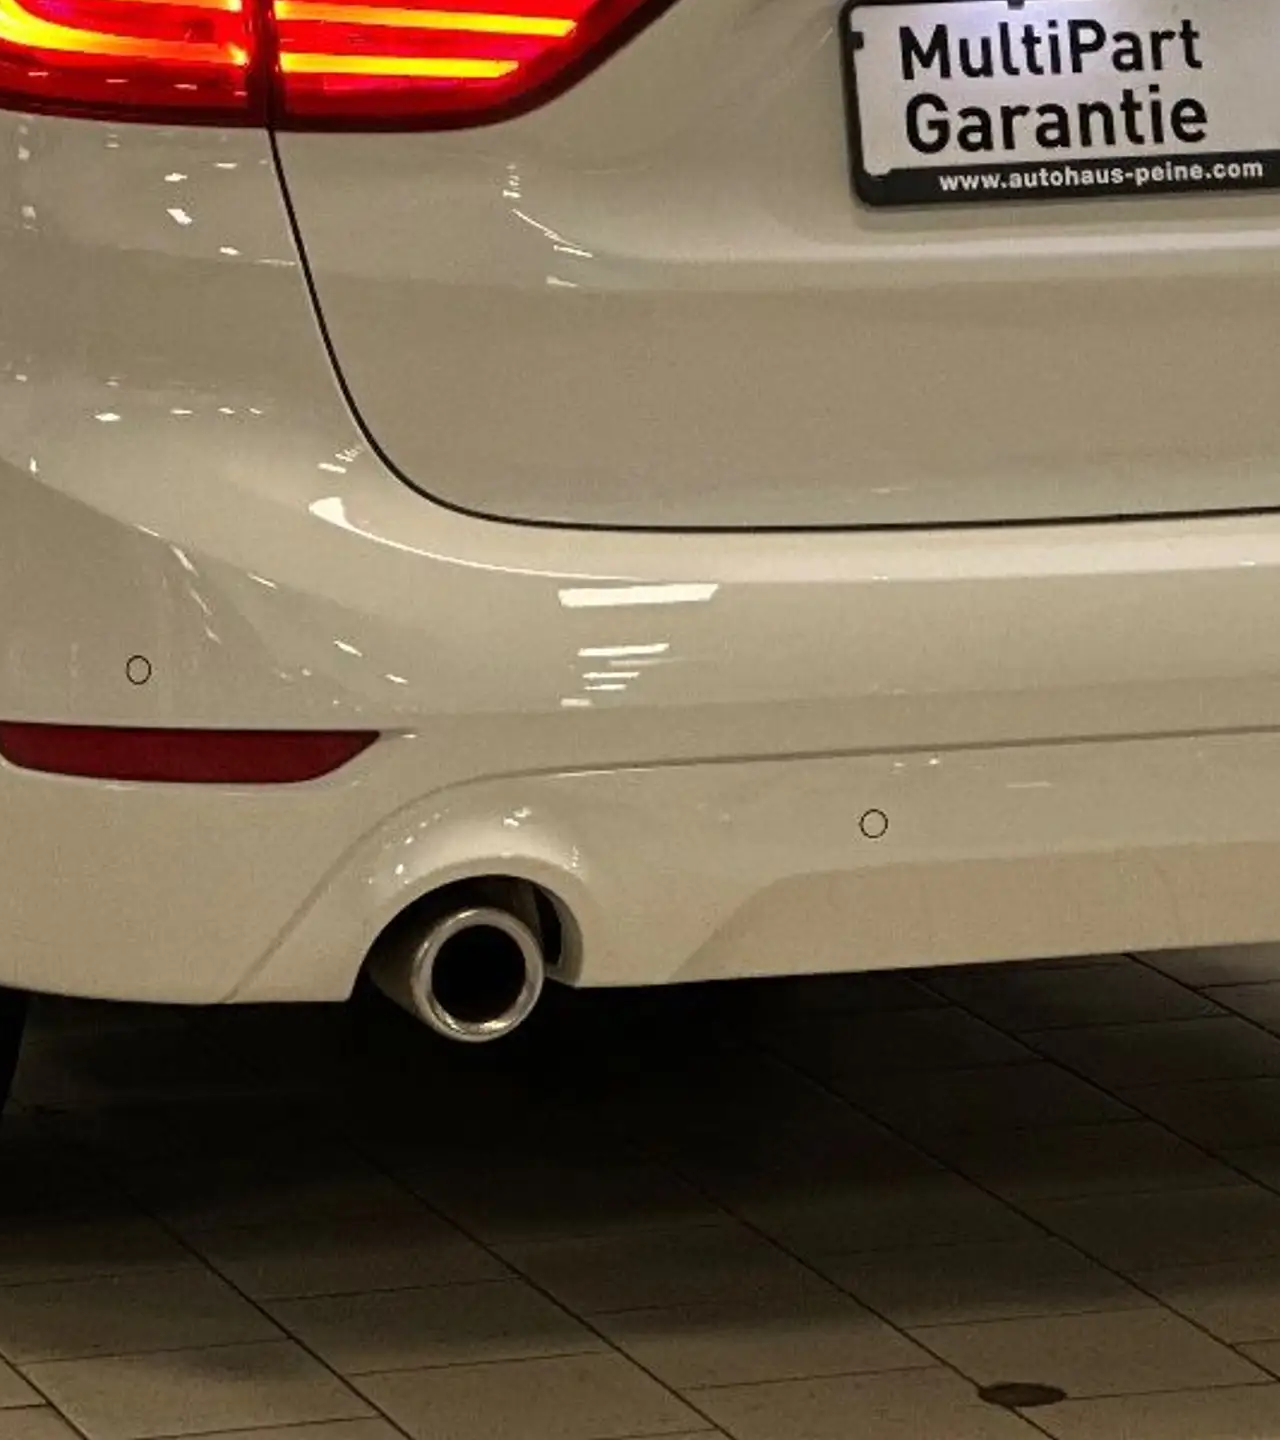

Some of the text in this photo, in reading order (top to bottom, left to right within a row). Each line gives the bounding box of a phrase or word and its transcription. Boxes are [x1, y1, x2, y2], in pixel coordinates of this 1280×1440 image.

[898, 19, 1203, 80] MultiPart
[905, 83, 1209, 154] Garantie
[939, 162, 1264, 192] www.autohaus-peine.com
